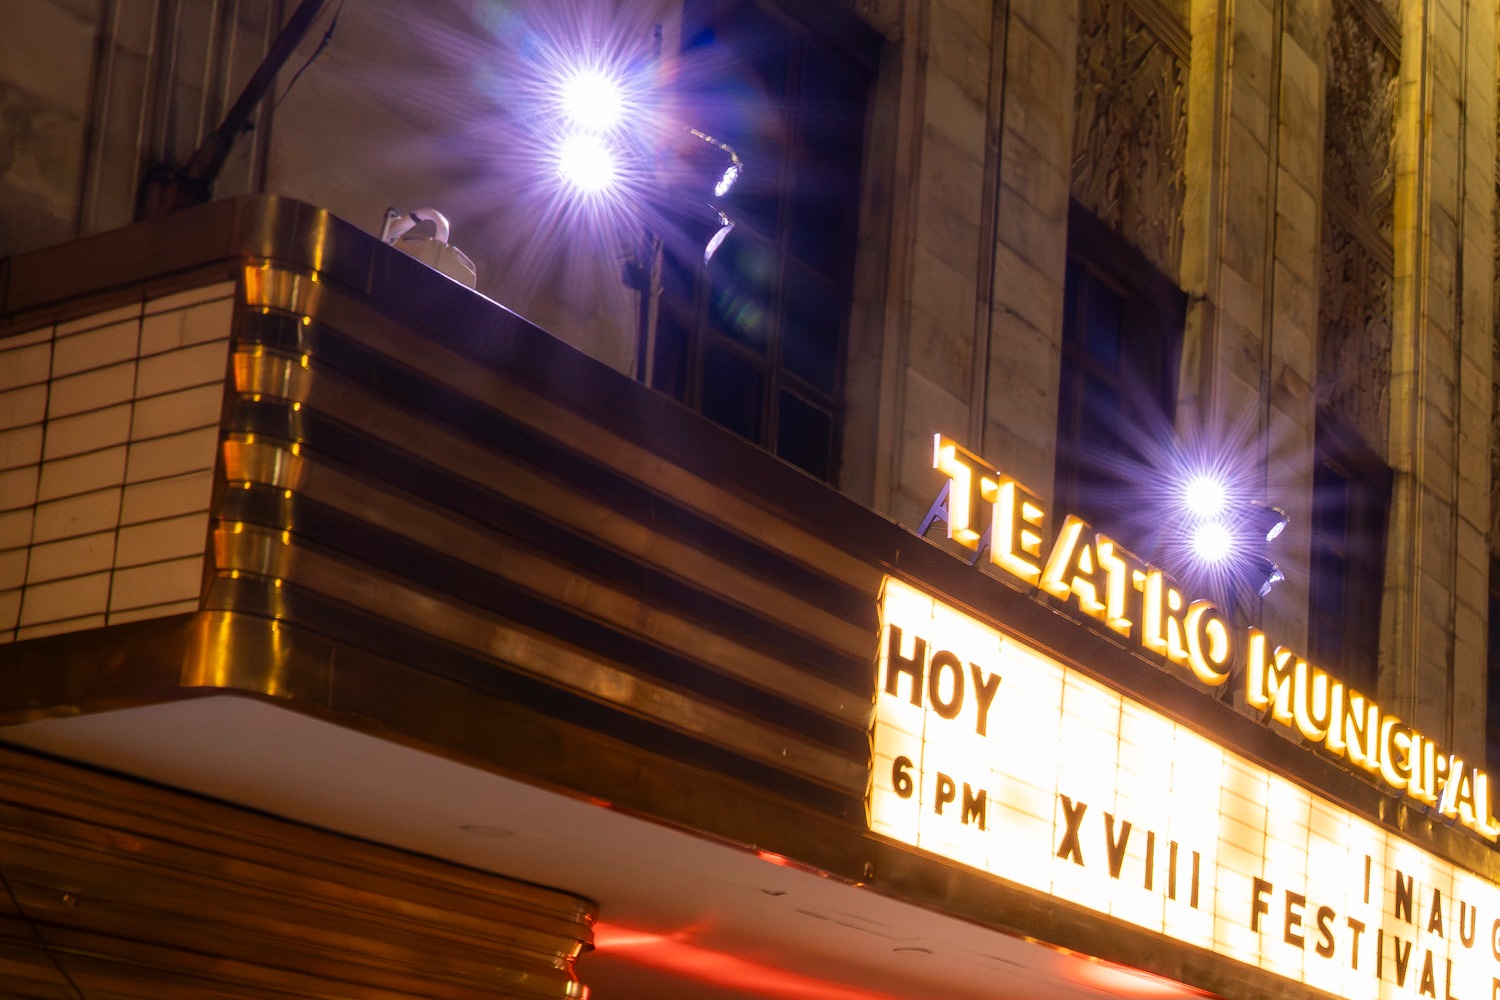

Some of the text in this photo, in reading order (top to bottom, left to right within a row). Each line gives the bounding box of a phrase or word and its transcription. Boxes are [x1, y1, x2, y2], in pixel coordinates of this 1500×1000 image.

[885, 623, 1002, 737] HOY
[933, 433, 1234, 686] TEATRO
[1247, 626, 1500, 842] MUNICIPAL
[892, 755, 988, 832] 6 PM
[1056, 793, 1200, 909] XVIII
